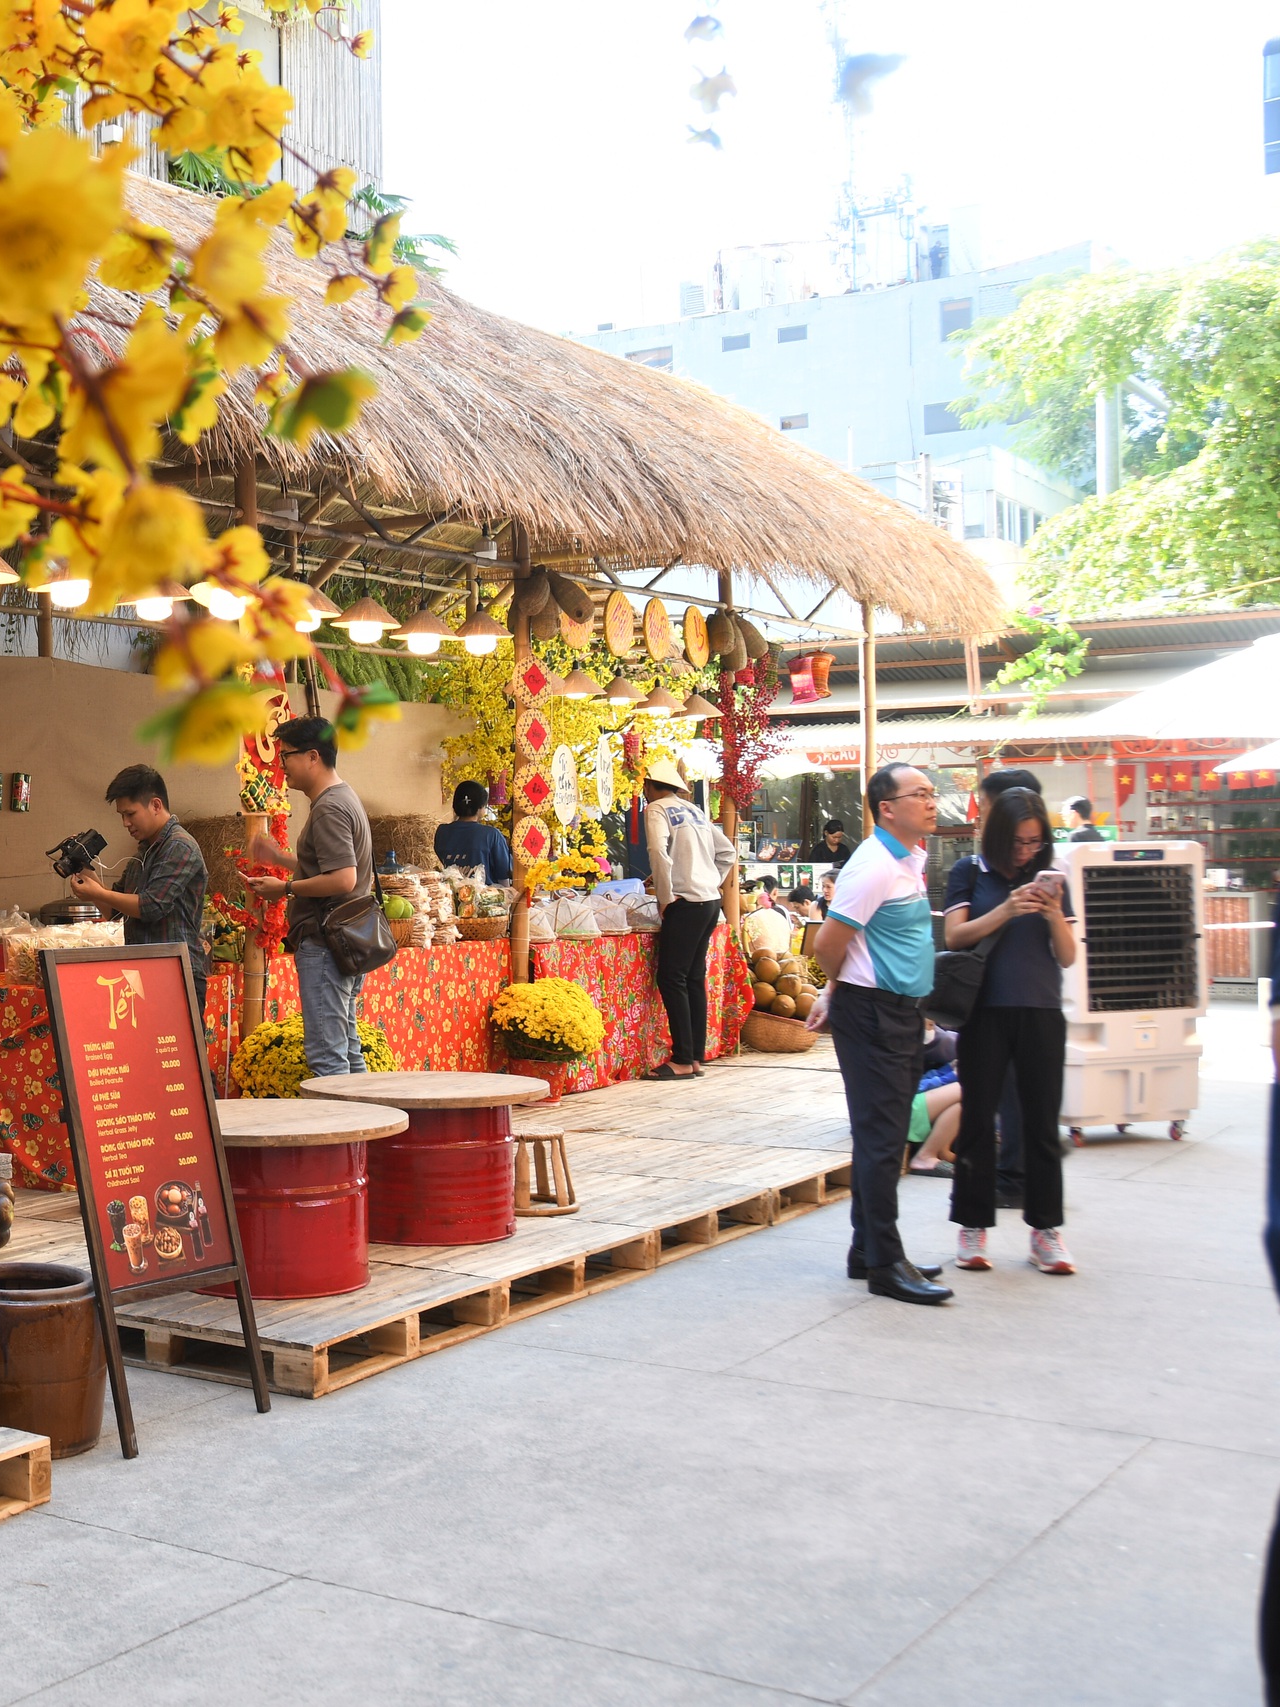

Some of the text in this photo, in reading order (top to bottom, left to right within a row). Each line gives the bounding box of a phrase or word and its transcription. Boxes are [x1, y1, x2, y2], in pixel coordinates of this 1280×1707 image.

[96, 975, 138, 1030] Tết
[85, 1052, 113, 1061] Braised Egg
[161, 1059, 181, 1069] 30.000
[89, 1077, 124, 1087] Boiled Peanuts
[165, 1083, 185, 1093] 40.000
[93, 1104, 103, 1112] Milk
[115, 1114, 127, 1125] SÁO
[127, 1112, 142, 1123] THẢO
[97, 1125, 138, 1137] Herbal Grass Jelly
[126, 1138, 141, 1149] THẢO
[102, 1153, 118, 1163] Herbal
[178, 1155, 198, 1166] 30.000
[104, 1168, 113, 1179] SÁ
[106, 1178, 130, 1188] Childhood
